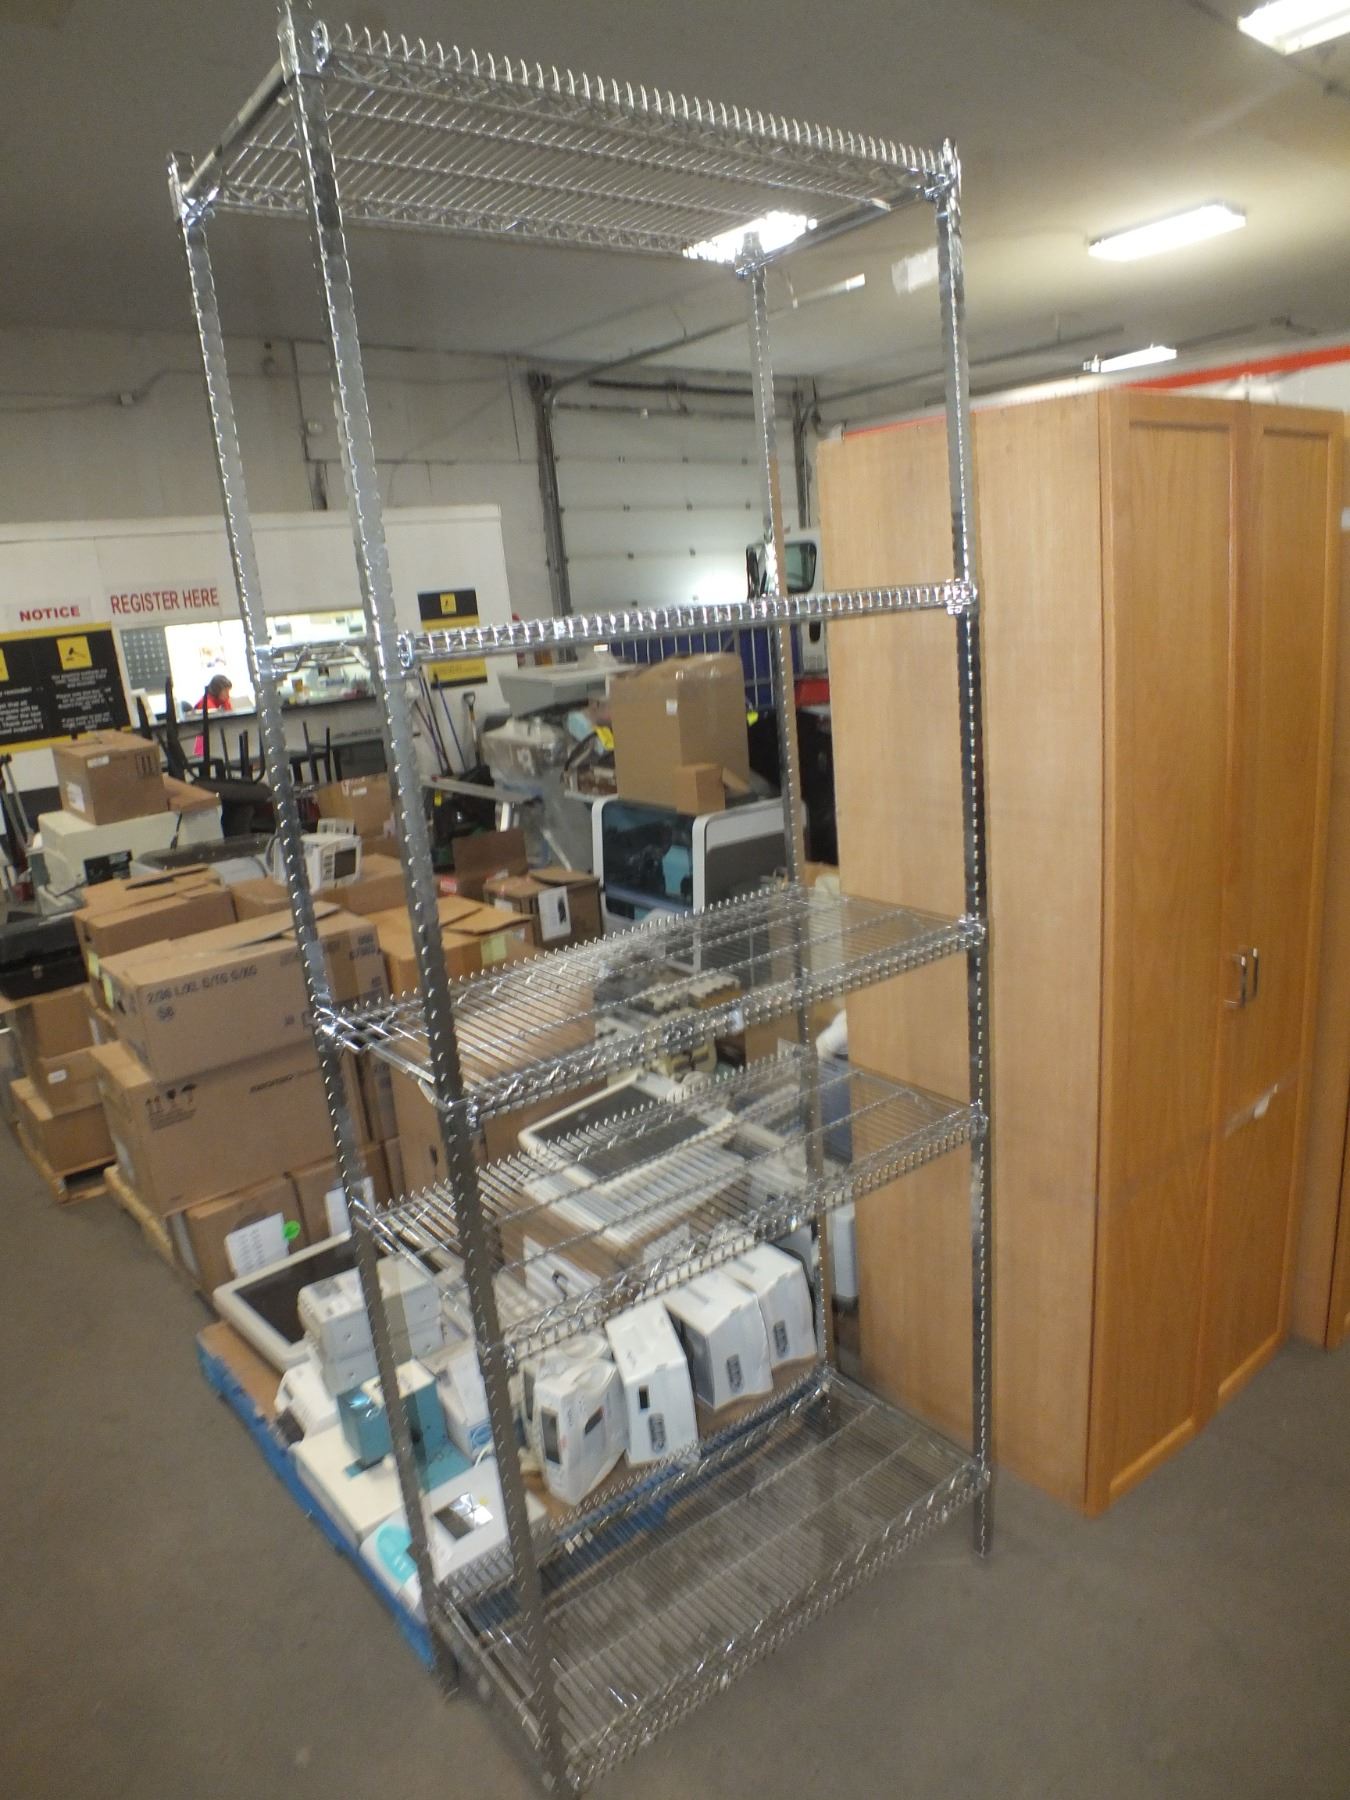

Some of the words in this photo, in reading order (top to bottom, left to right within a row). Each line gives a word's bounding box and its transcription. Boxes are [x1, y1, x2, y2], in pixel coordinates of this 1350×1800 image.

[110, 591, 180, 615] REGISTER
[182, 587, 219, 609] HERE
[19, 605, 81, 622] NOTICE
